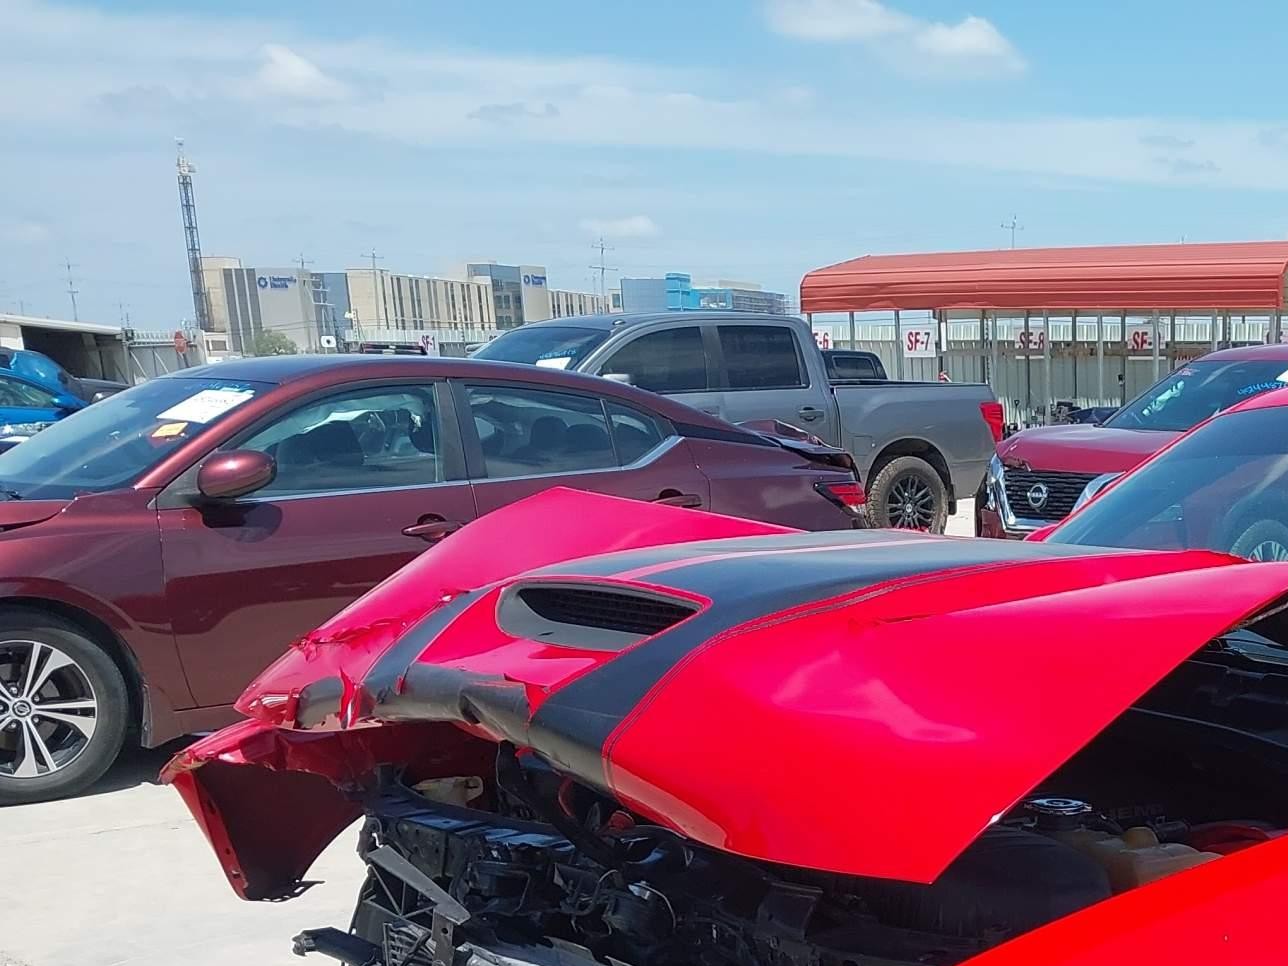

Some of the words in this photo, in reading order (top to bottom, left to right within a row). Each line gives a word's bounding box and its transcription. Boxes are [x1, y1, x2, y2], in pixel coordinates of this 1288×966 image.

[421, 334, 436, 351] SF-1
[907, 331, 931, 352] SF-7
[1132, 331, 1161, 350] SF-
